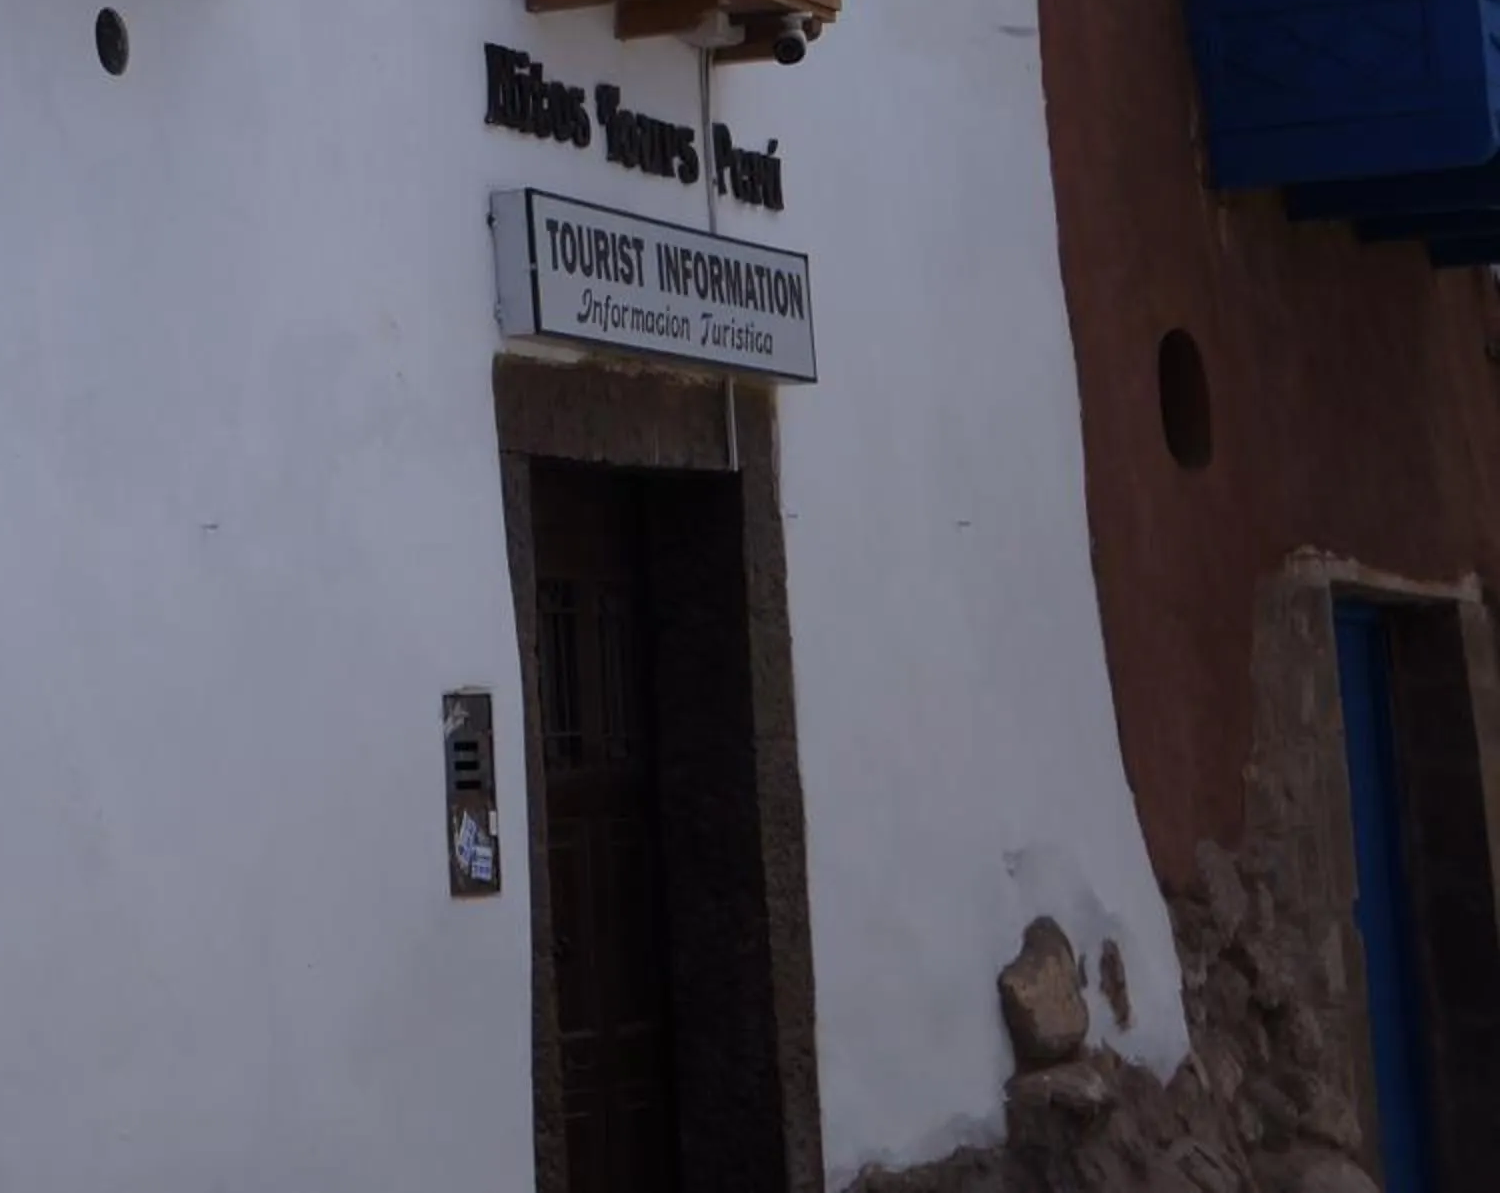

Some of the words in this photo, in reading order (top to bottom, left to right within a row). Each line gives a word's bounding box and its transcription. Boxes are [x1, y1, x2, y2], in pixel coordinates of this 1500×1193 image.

[595, 83, 700, 185] Tours
[545, 218, 646, 288] TOURIST
[656, 242, 806, 321] INFORMATION
[576, 288, 692, 342] Informacion
[700, 311, 775, 356] Turistica
